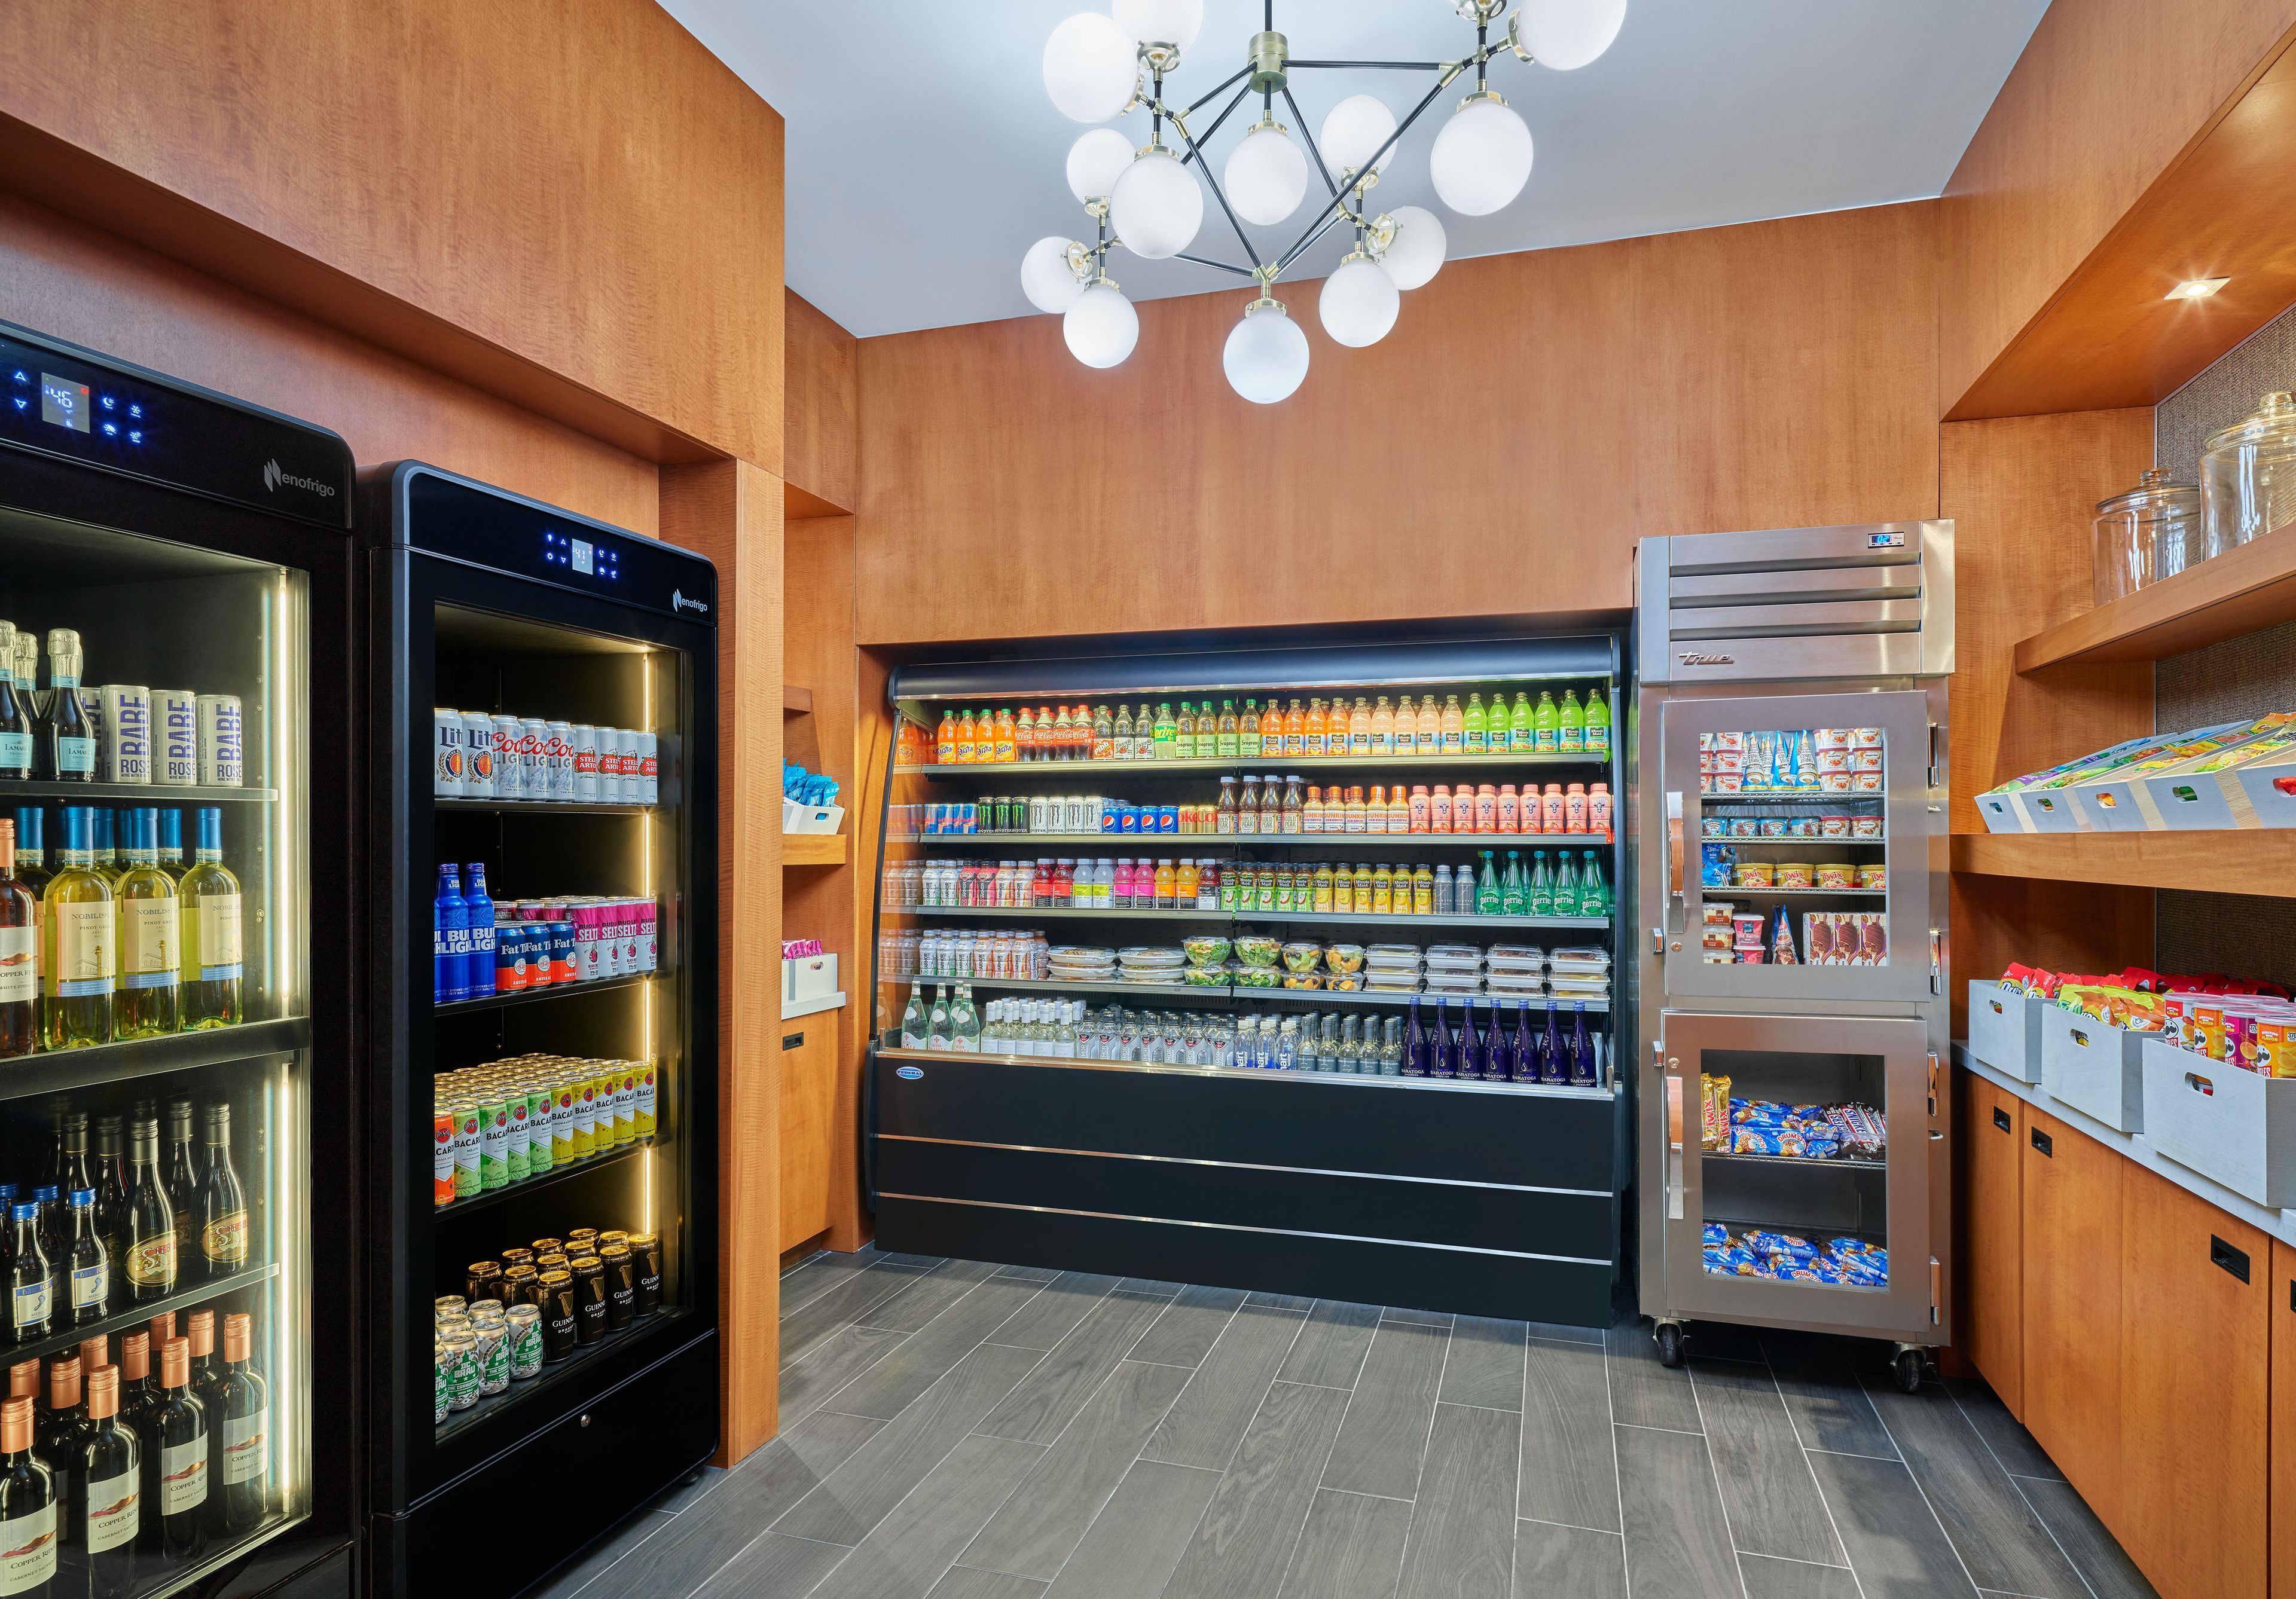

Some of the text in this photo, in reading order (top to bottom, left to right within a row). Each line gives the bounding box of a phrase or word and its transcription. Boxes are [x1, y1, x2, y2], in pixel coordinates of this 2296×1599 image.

[50, 387, 72, 408] 46
[120, 695, 149, 756] BABE
[167, 699, 195, 759] BABE
[216, 704, 242, 761] BABE
[439, 726, 463, 748] Lit
[996, 745, 1012, 755] anta
[1178, 809, 1196, 823] oke
[579, 928, 598, 941] SELTZ
[602, 926, 618, 939] SELT
[618, 924, 636, 937] SELTZ
[641, 923, 656, 934] SELT
[448, 930, 469, 942] BU
[441, 941, 469, 953] LIGH
[469, 938, 496, 950] LIGH
[526, 942, 543, 952] Fat
[554, 939, 570, 948] Fat
[501, 945, 519, 955] Fat
[552, 1110, 573, 1120] BACAR
[507, 1122, 529, 1133] BACARD
[531, 1116, 552, 1127] BACAR
[435, 1144, 454, 1156] CARD
[642, 1274, 659, 1285] GUINN
[1791, 1270, 1823, 1283] DRUMST
[552, 1315, 574, 1327] GUINNE
[496, 1352, 509, 1360] BRA
[454, 1365, 475, 1378] BRAU
[232, 1451, 255, 1462] COPPER
[170, 1479, 196, 1491] COPPER
[170, 1493, 194, 1503] CABERNET
[99, 1515, 126, 1528] COPPER
[97, 1530, 123, 1540] CABERNET
[11, 1555, 41, 1569] COPPER
[10, 1570, 38, 1582] CABERNET
